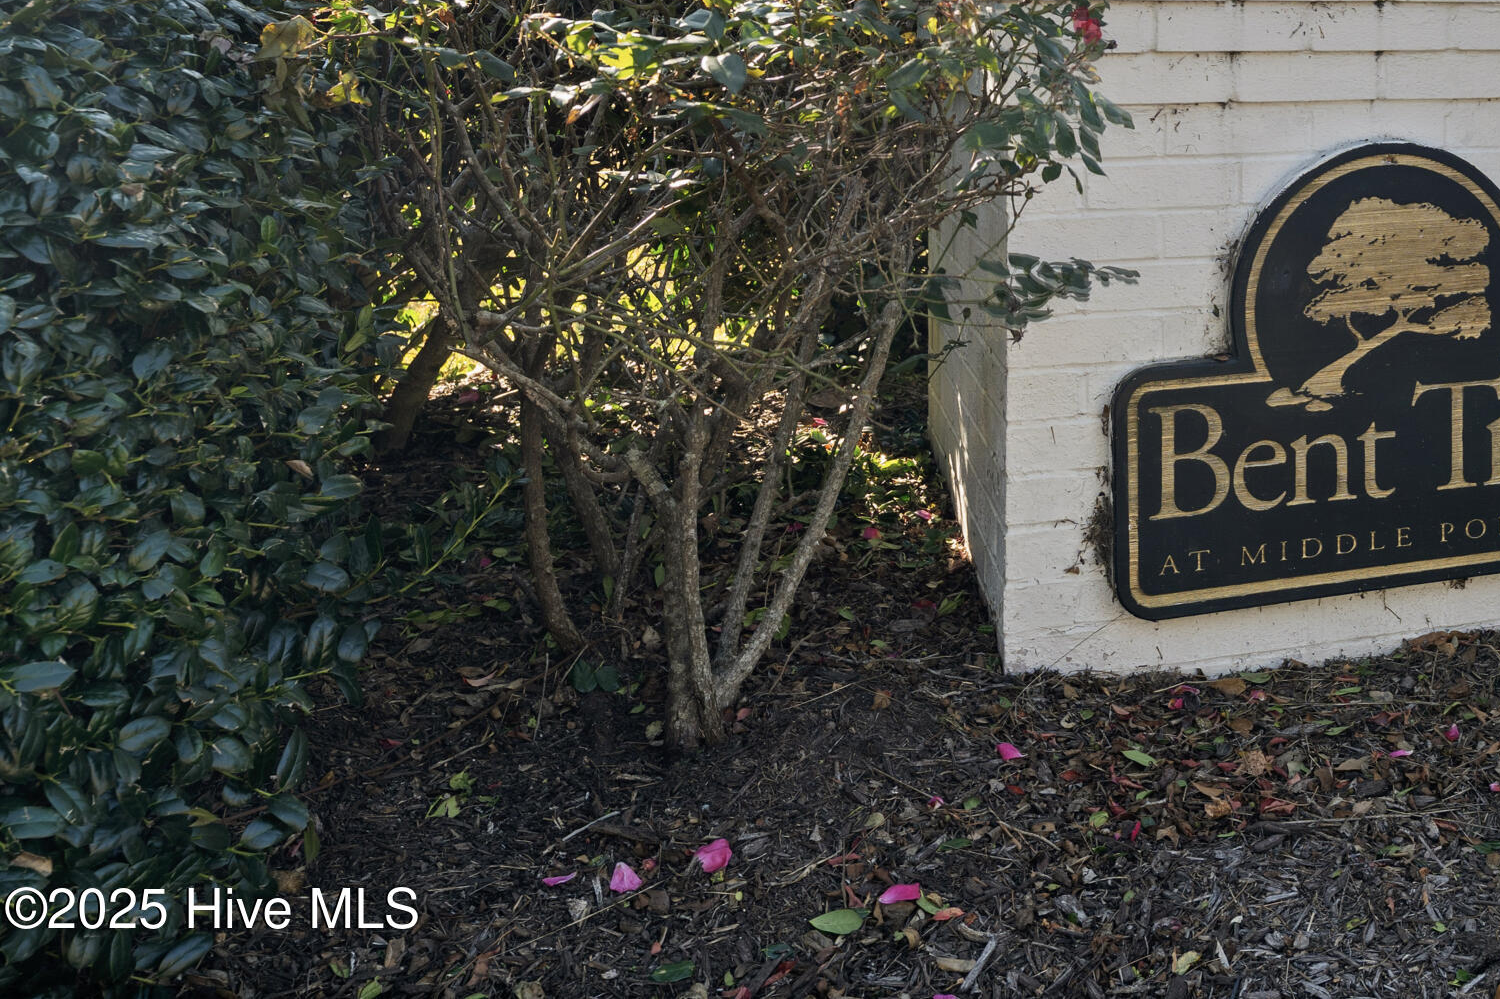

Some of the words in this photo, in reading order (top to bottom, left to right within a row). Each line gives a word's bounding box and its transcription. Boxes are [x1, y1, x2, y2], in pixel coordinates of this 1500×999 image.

[1148, 403, 1396, 521] Bent
[1159, 549, 1211, 576] AT
[1240, 526, 1413, 566] MIDDLE
